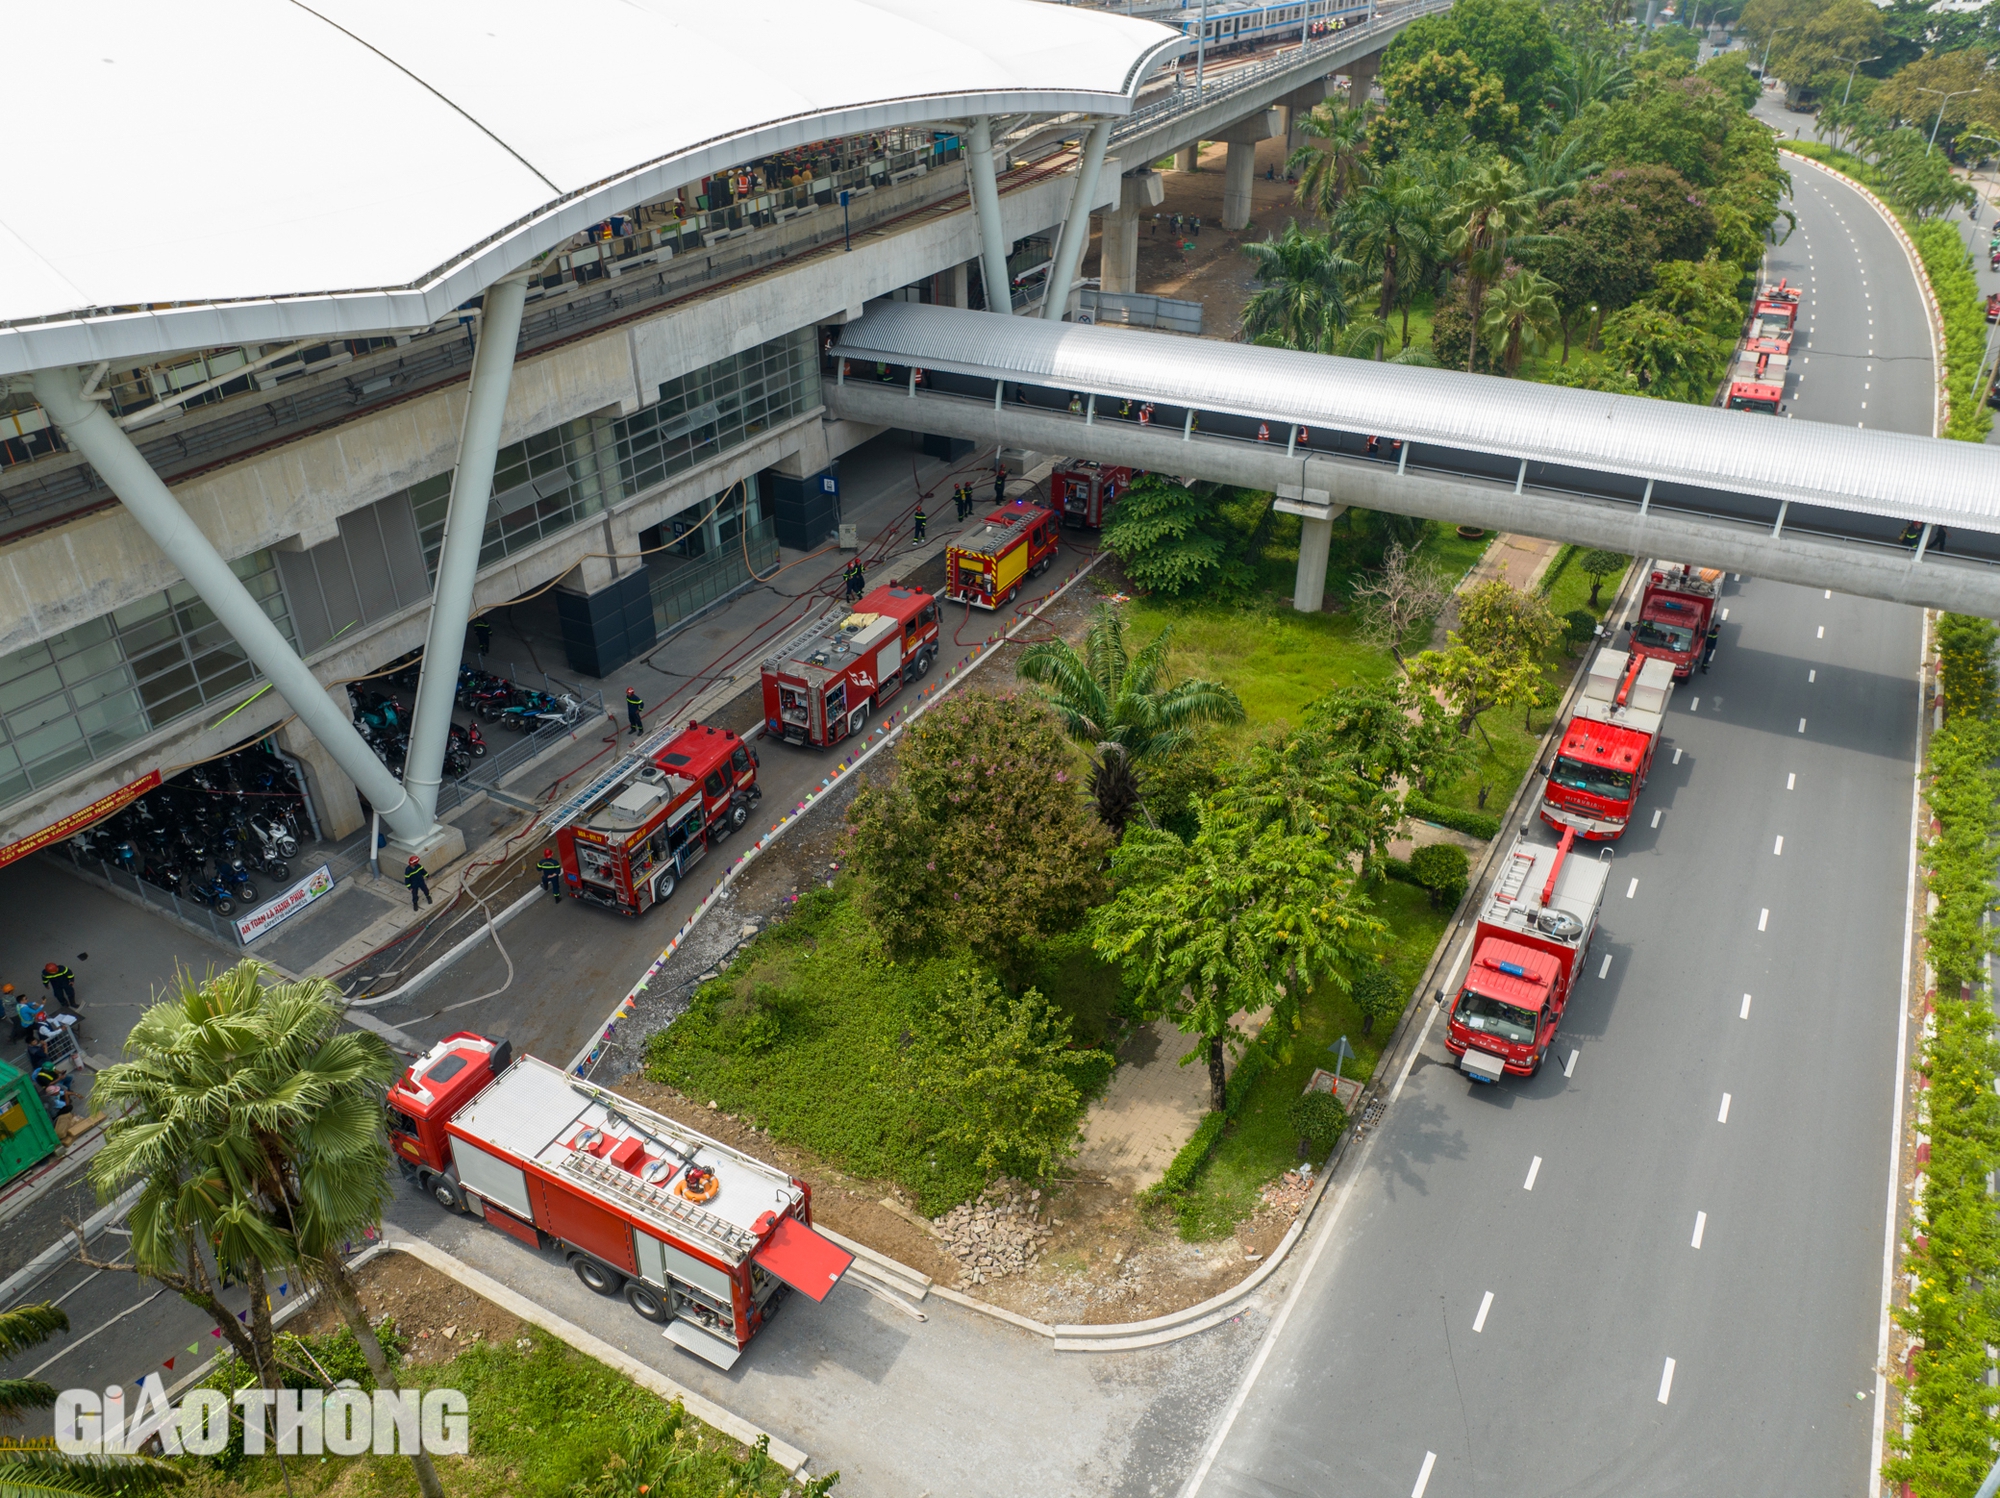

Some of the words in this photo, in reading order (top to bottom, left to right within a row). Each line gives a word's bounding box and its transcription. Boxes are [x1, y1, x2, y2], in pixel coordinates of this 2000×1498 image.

[241, 923, 251, 935] AN
[250, 914, 266, 929] TOÀN
[266, 909, 275, 921] LÀ
[274, 900, 291, 914] HẠNH
[289, 889, 306, 905] PHÚC
